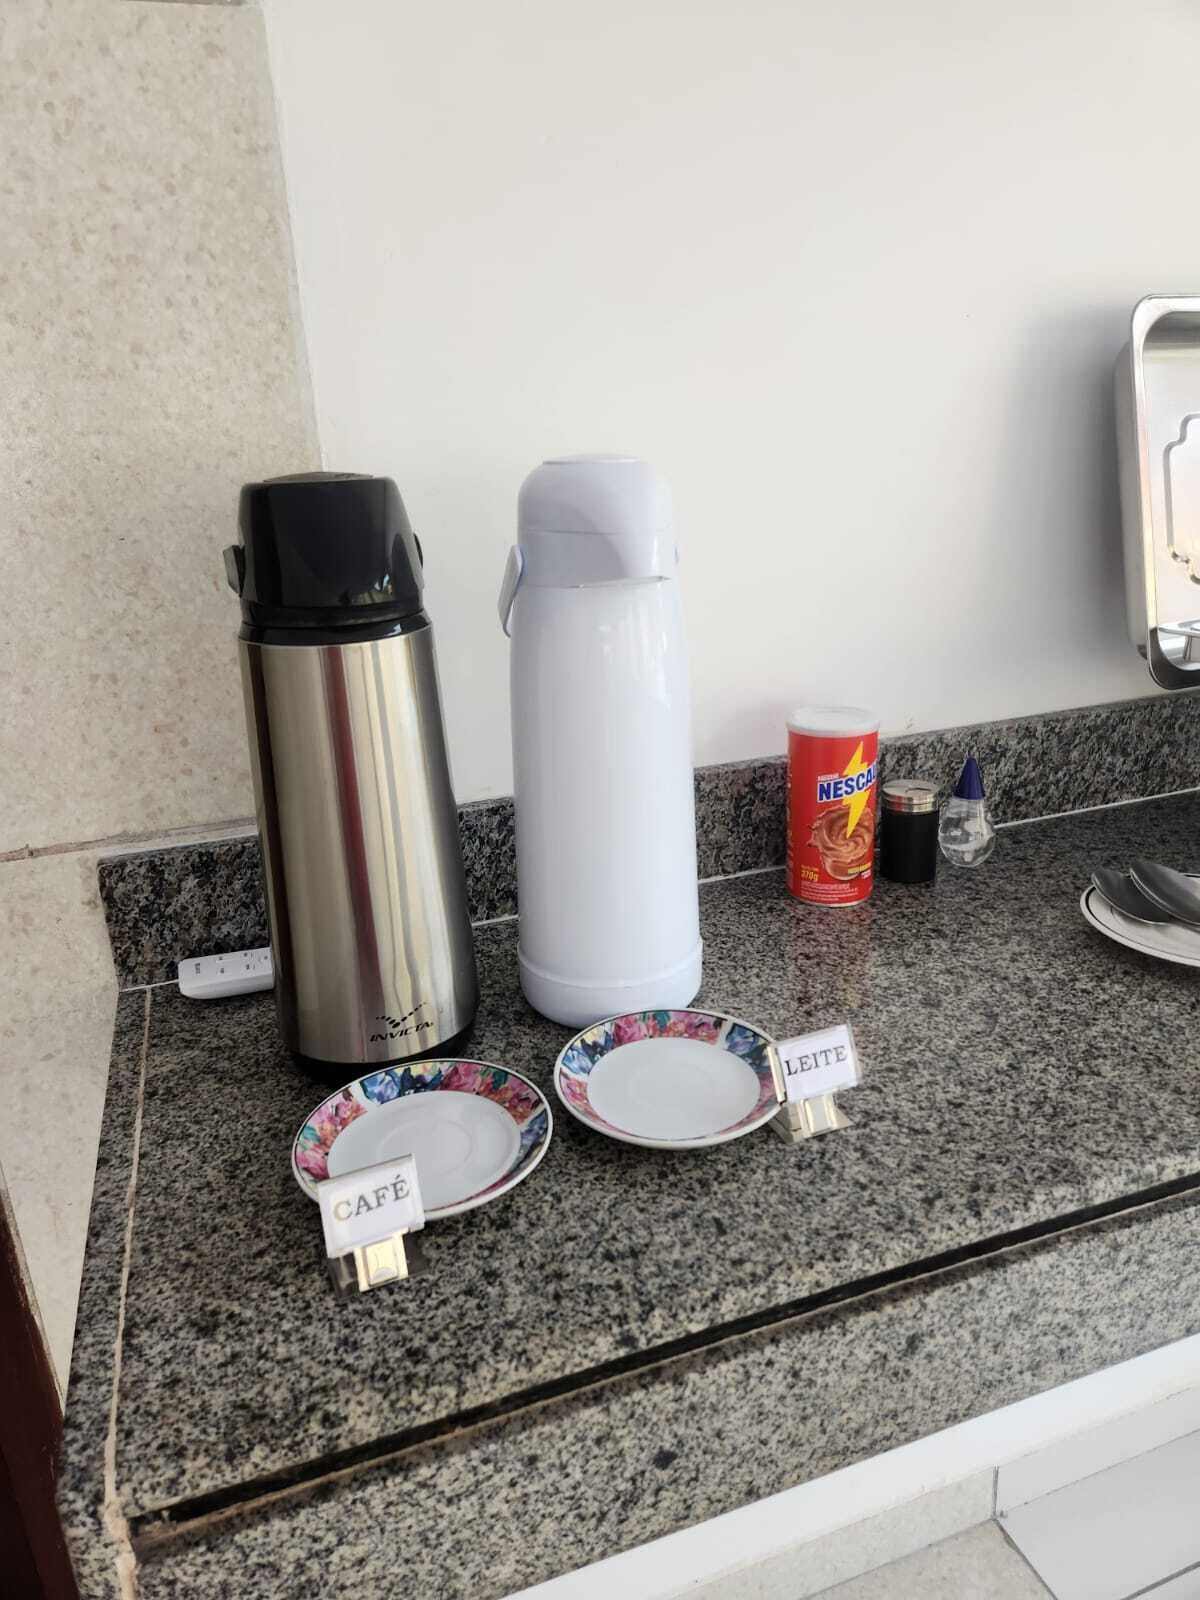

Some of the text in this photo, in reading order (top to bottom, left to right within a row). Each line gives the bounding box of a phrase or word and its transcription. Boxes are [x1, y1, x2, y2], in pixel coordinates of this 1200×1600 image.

[369, 1021, 431, 1042] INVICTA
[784, 1045, 848, 1076] LEITE
[333, 1174, 410, 1222] CAFÉ
